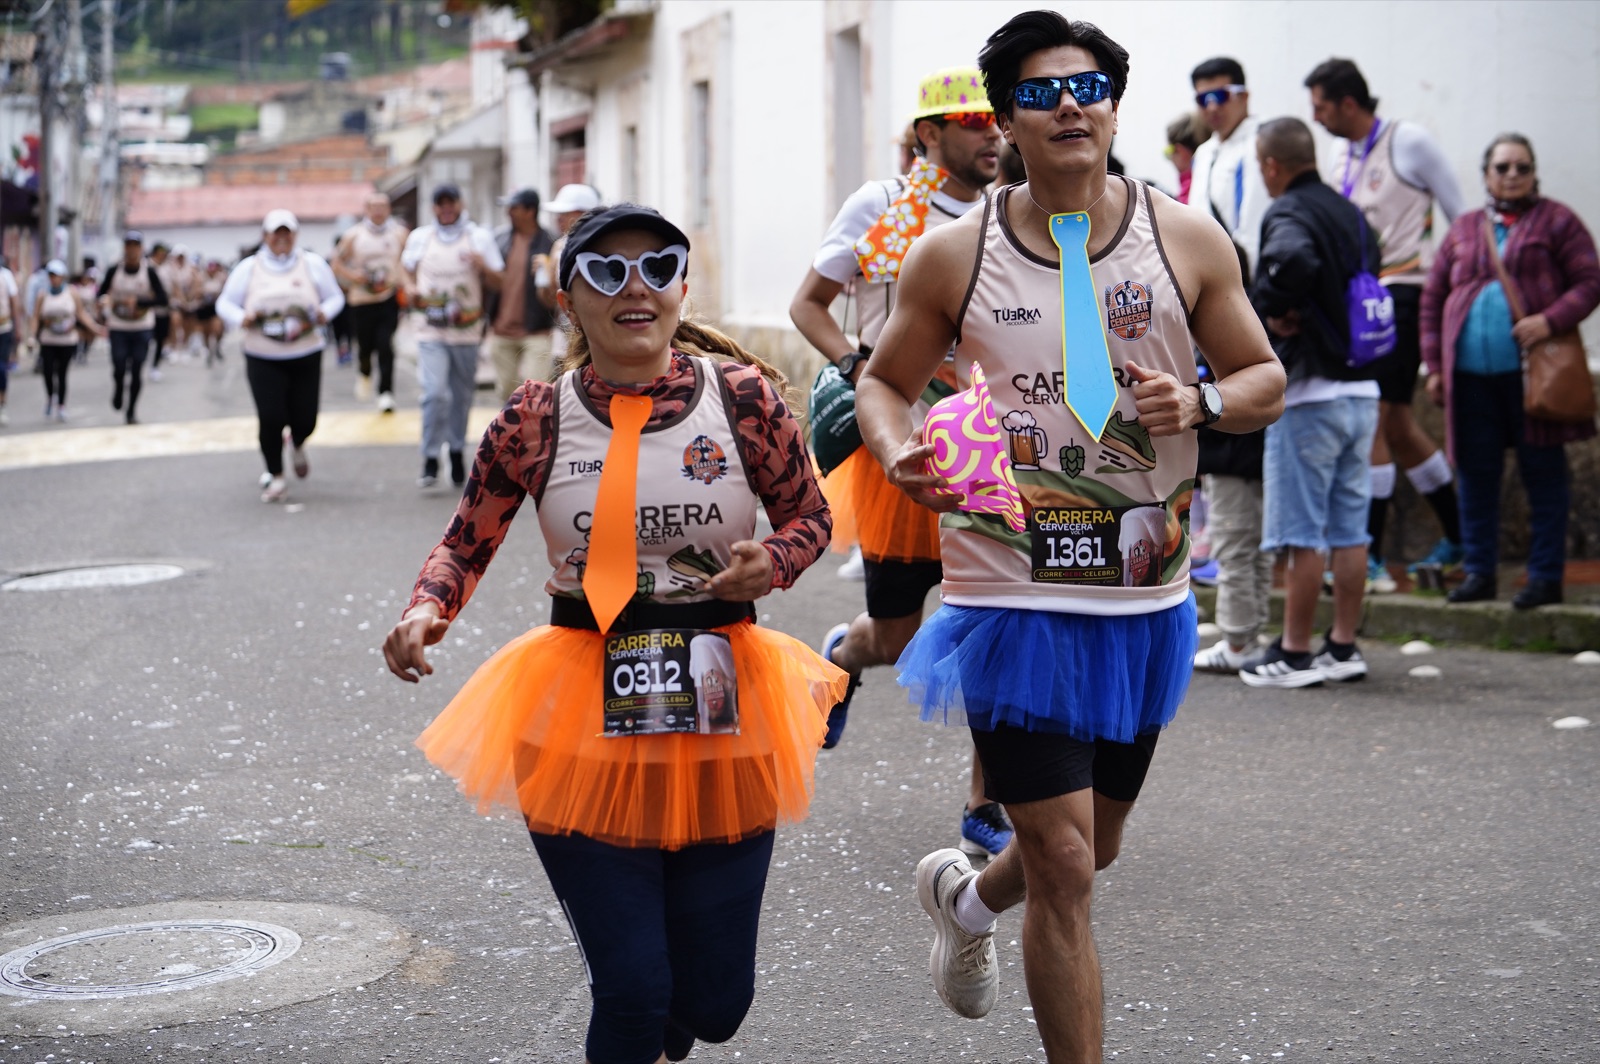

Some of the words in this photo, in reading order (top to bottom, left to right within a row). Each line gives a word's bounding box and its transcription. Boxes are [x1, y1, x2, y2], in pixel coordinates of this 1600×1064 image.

[1109, 303, 1149, 319] CARRERA
[1110, 311, 1150, 327] CERVECERA
[573, 503, 723, 533] CRERA
[1035, 510, 1115, 524] CARRERA
[1040, 523, 1093, 531] CERVECERA
[1046, 537, 1106, 567] 1361
[607, 633, 685, 654] CARRERA
[611, 646, 663, 660] CERVECERA
[613, 660, 682, 696] 0312
